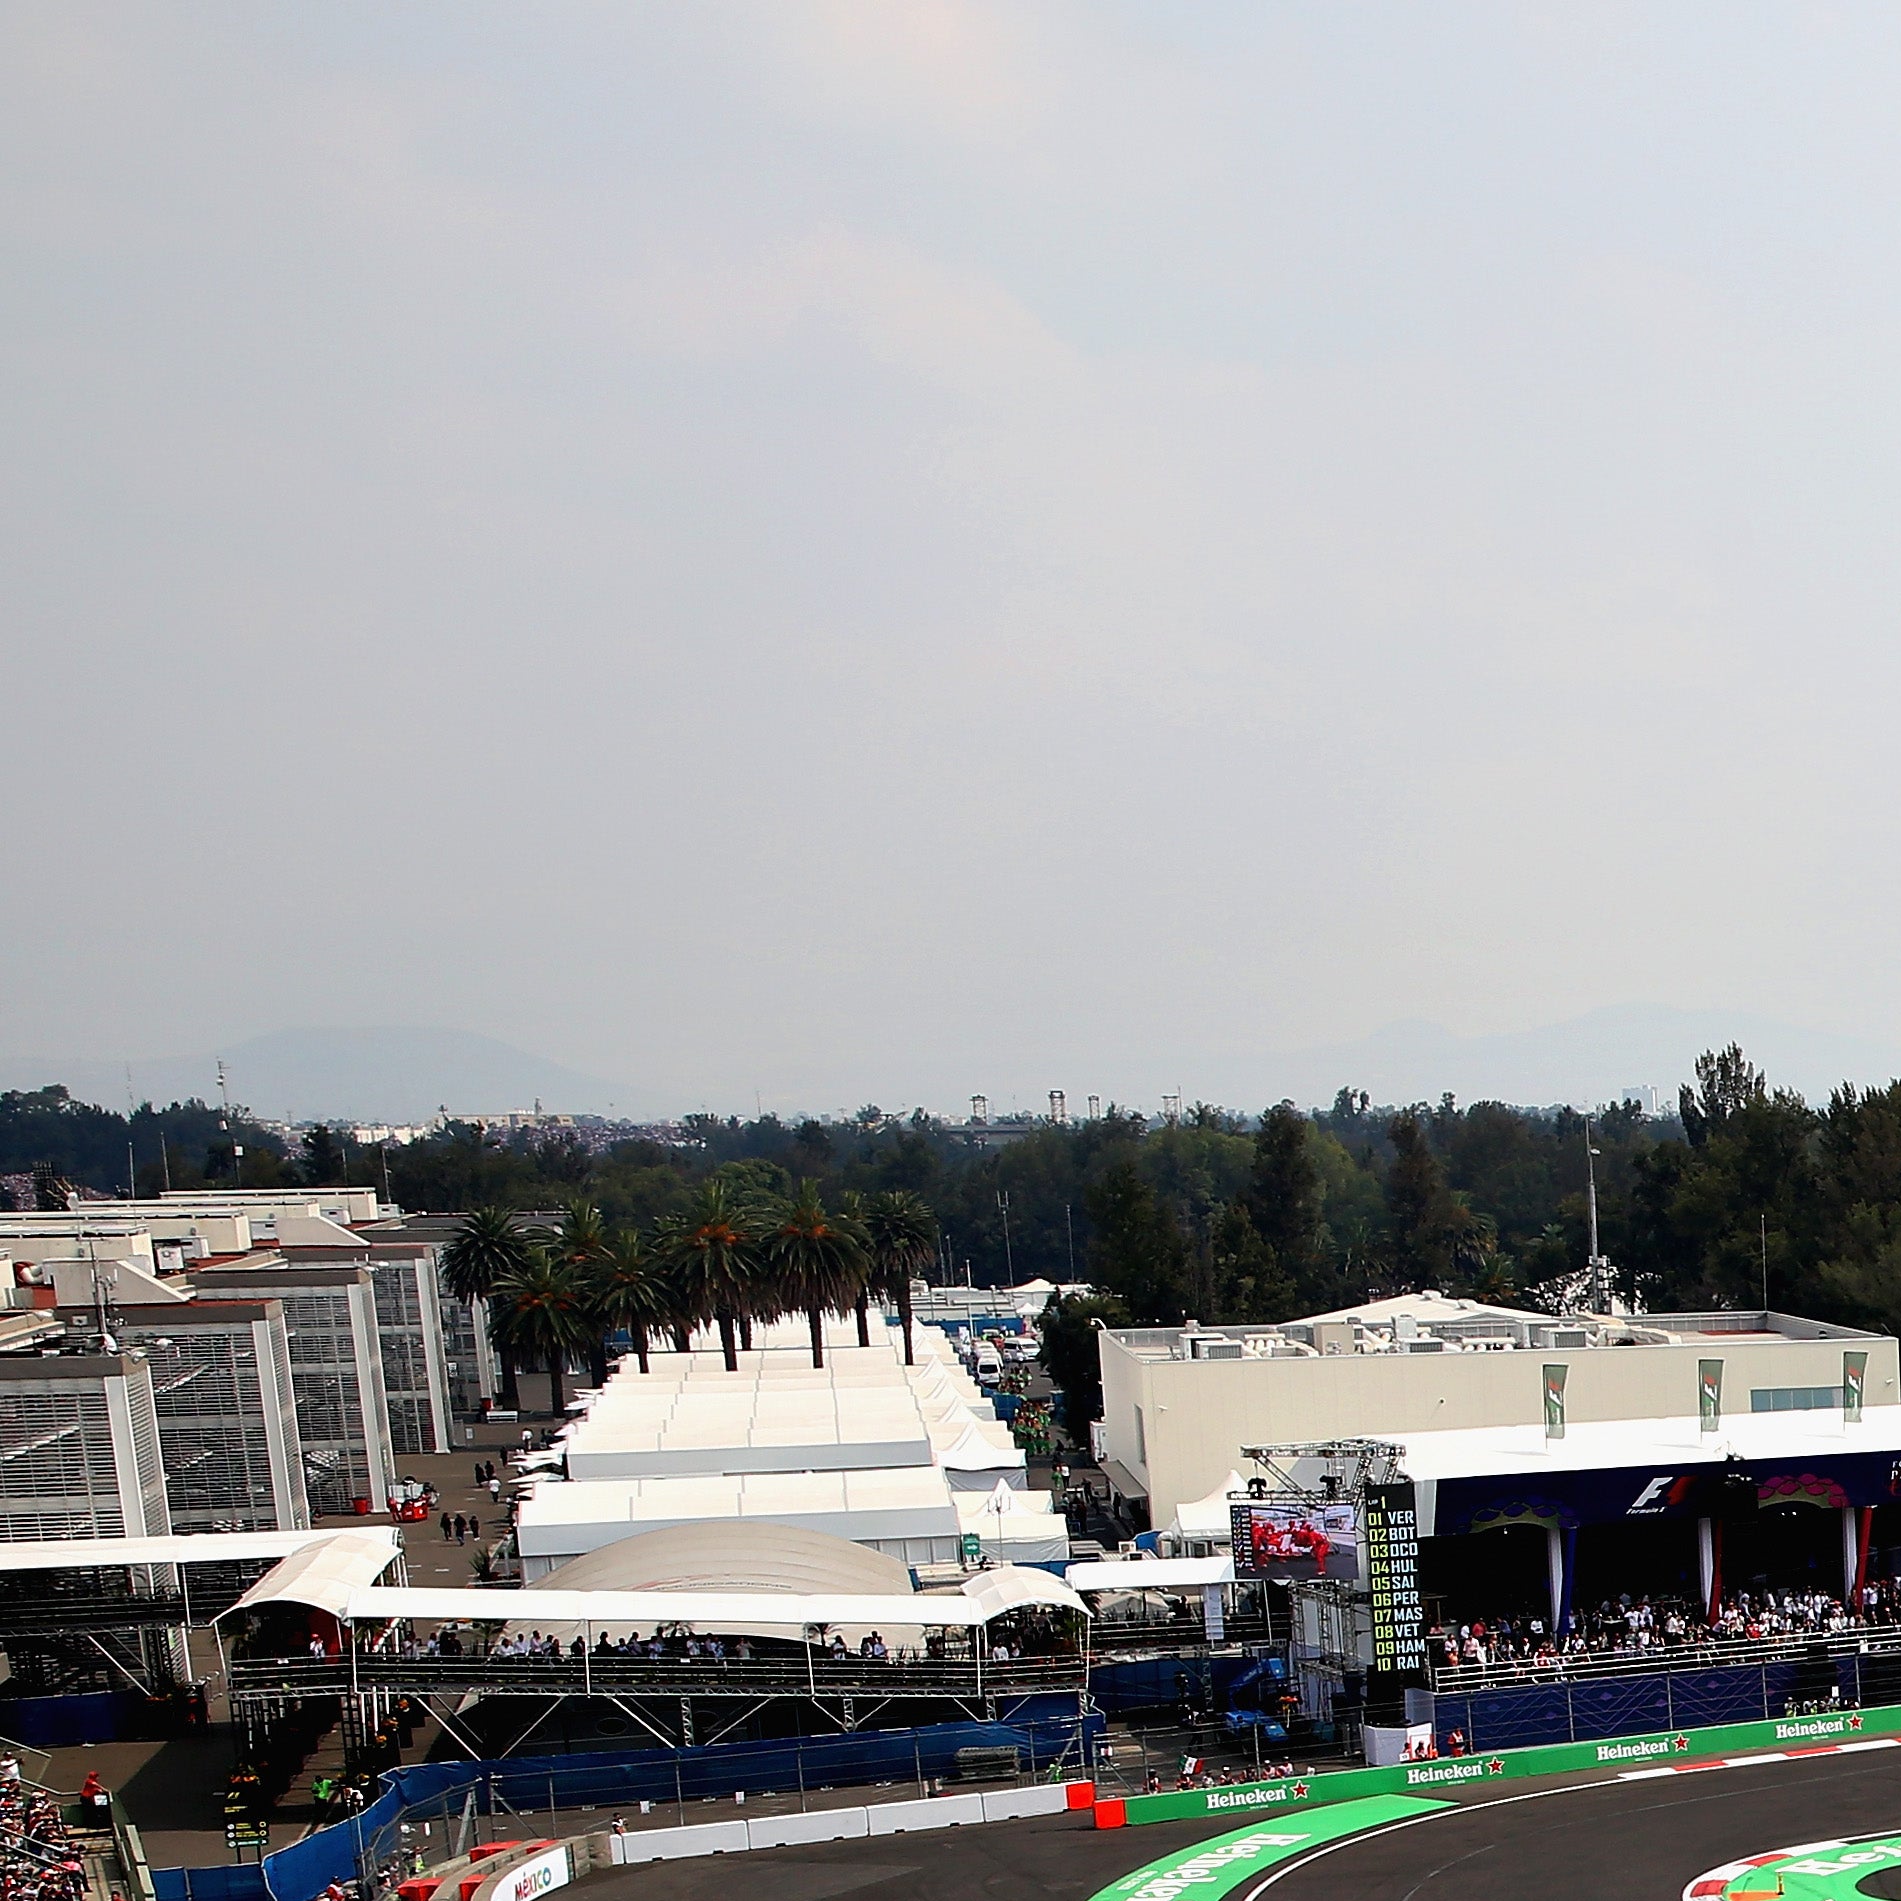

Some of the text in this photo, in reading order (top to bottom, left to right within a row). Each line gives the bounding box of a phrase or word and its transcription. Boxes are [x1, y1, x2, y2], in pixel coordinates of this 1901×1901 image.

[1368, 1511, 1414, 1525] 01 VER
[1369, 1527, 1415, 1542] 02 BOT
[1370, 1543, 1418, 1558] 03 OCO
[1371, 1560, 1418, 1574] 04 HUL
[1372, 1576, 1414, 1590] 05 SAI
[1373, 1592, 1419, 1606] 06 PER
[1374, 1608, 1422, 1623] 07 MAS
[1375, 1624, 1419, 1639] 08 VET
[1376, 1640, 1425, 1655] 09 HAM
[1378, 1657, 1419, 1671] 10 RAI
[1775, 1717, 1846, 1738] Heineken
[1596, 1739, 1669, 1761] Heineken
[1407, 1763, 1483, 1785] Heineken
[1206, 1787, 1287, 1810] Heineken
